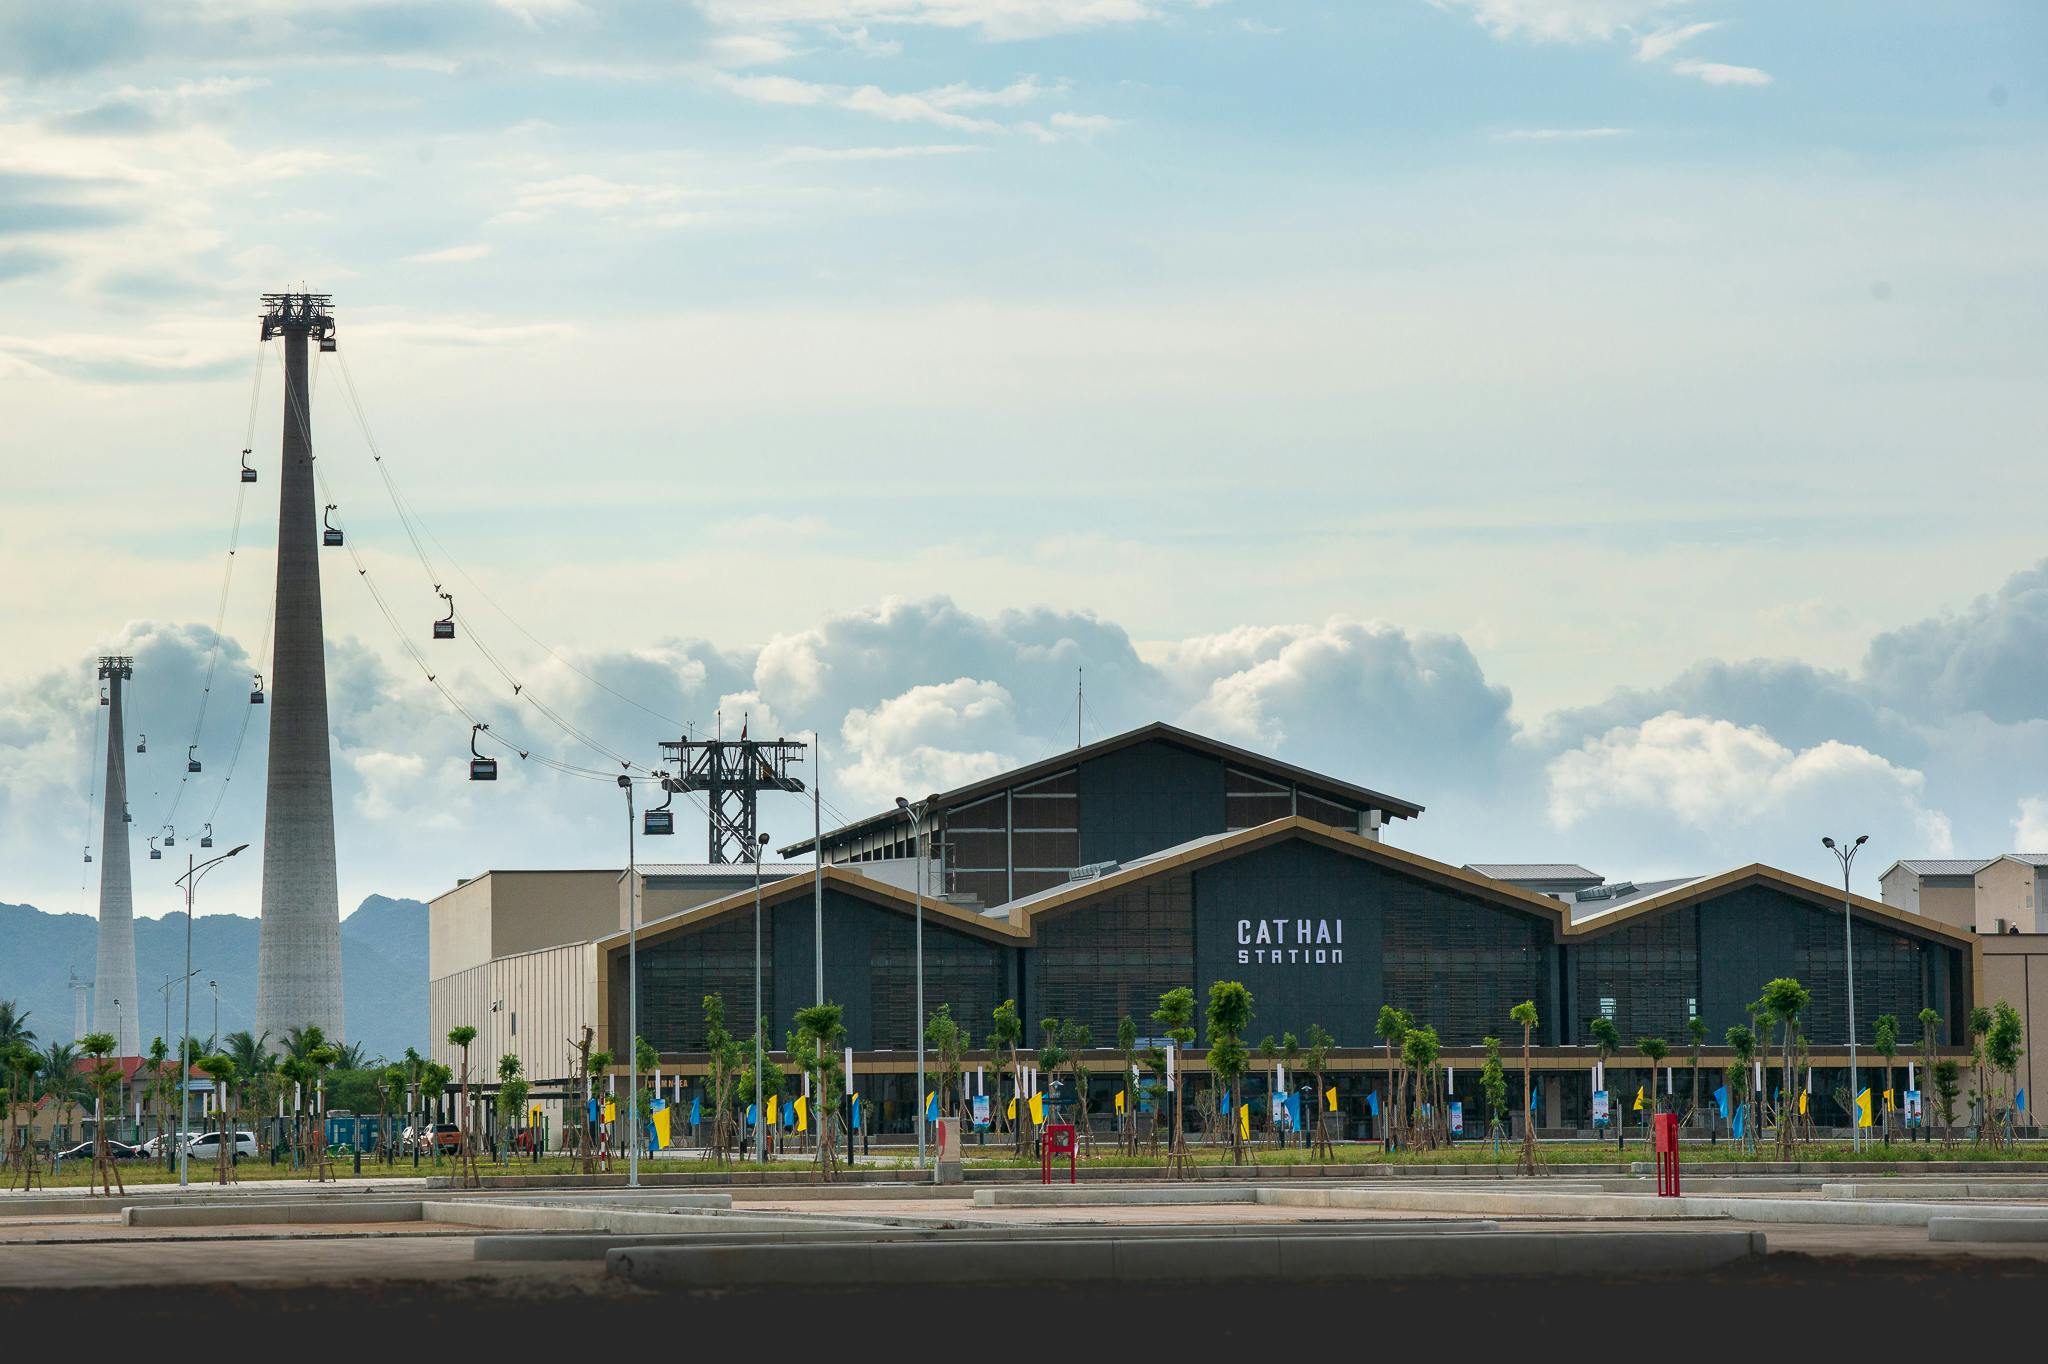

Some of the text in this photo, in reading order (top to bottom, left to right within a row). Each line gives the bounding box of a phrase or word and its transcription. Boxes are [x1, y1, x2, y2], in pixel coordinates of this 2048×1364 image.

[1237, 919, 1342, 945] CAT HAI
[1238, 949, 1343, 964] STATION
